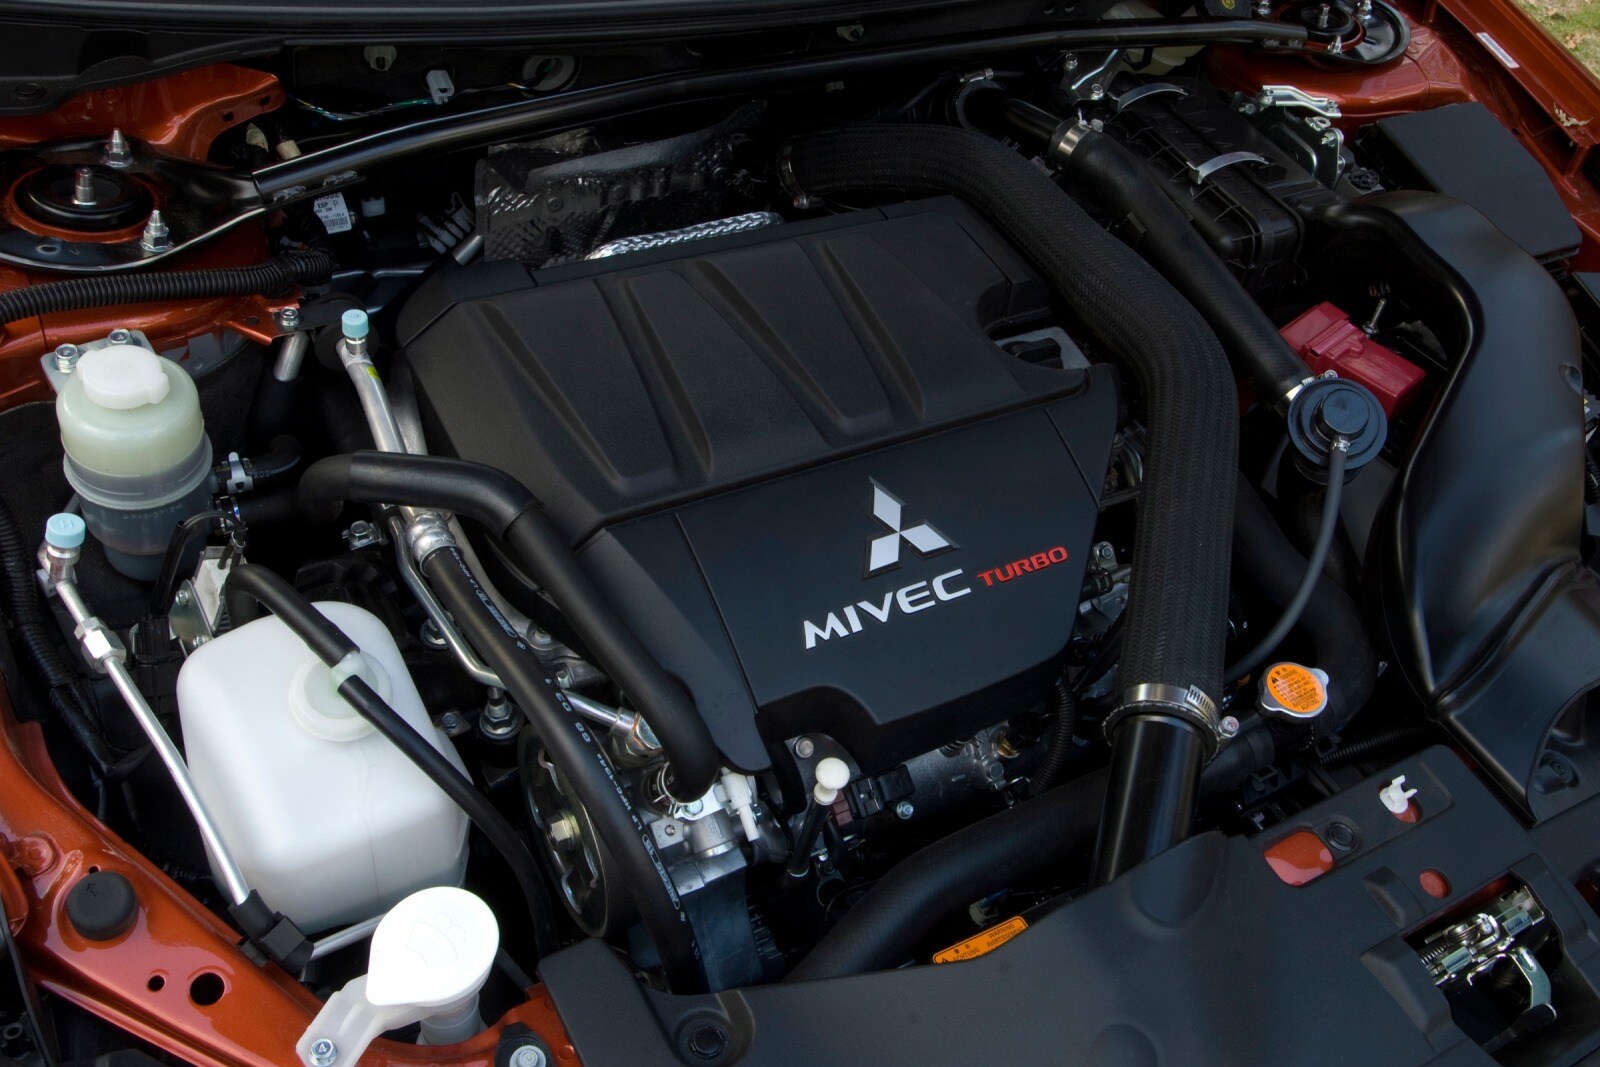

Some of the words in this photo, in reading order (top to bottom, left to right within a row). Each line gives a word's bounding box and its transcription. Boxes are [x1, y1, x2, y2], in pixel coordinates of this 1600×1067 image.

[803, 568, 972, 650] MIVEC
[977, 546, 1068, 587] TURBO
[987, 923, 1015, 939] WARNING
